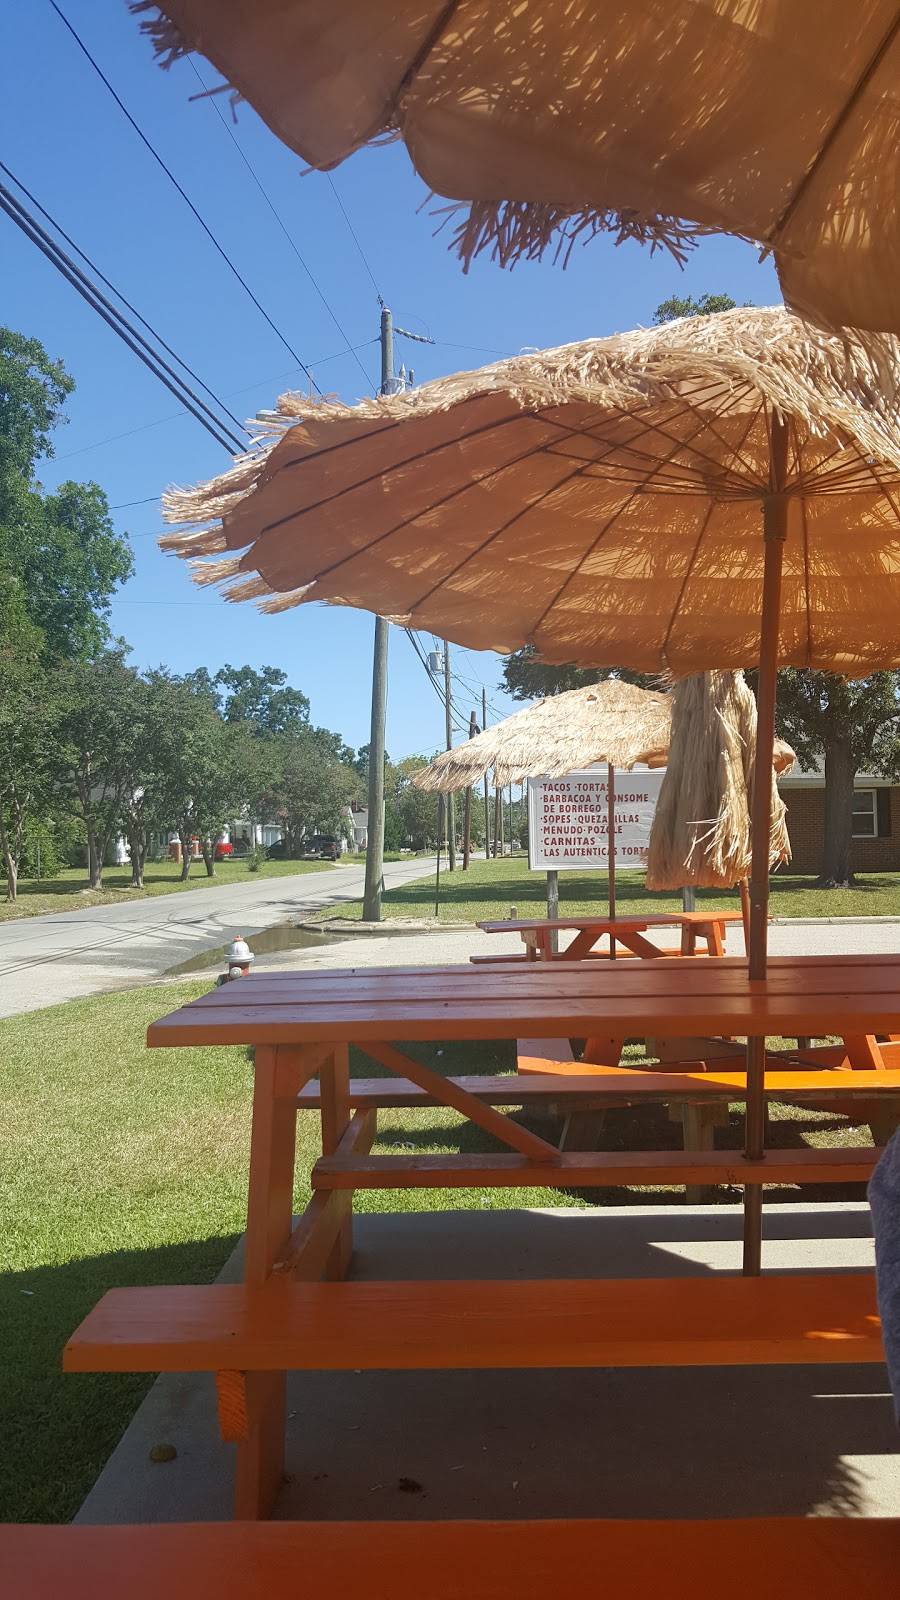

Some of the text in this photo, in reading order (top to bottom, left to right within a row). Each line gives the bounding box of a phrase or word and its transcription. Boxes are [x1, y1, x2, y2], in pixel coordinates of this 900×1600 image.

[543, 783, 571, 792] TACOS
[543, 794, 591, 803] BARBACOA
[595, 794, 601, 803] Y
[544, 804, 601, 813] DE BORREGO
[543, 814, 640, 824] SOPES QUEZAILLAS
[543, 826, 583, 835] MENUDO
[543, 837, 596, 846] CARNITAS
[544, 848, 560, 857] LAS
